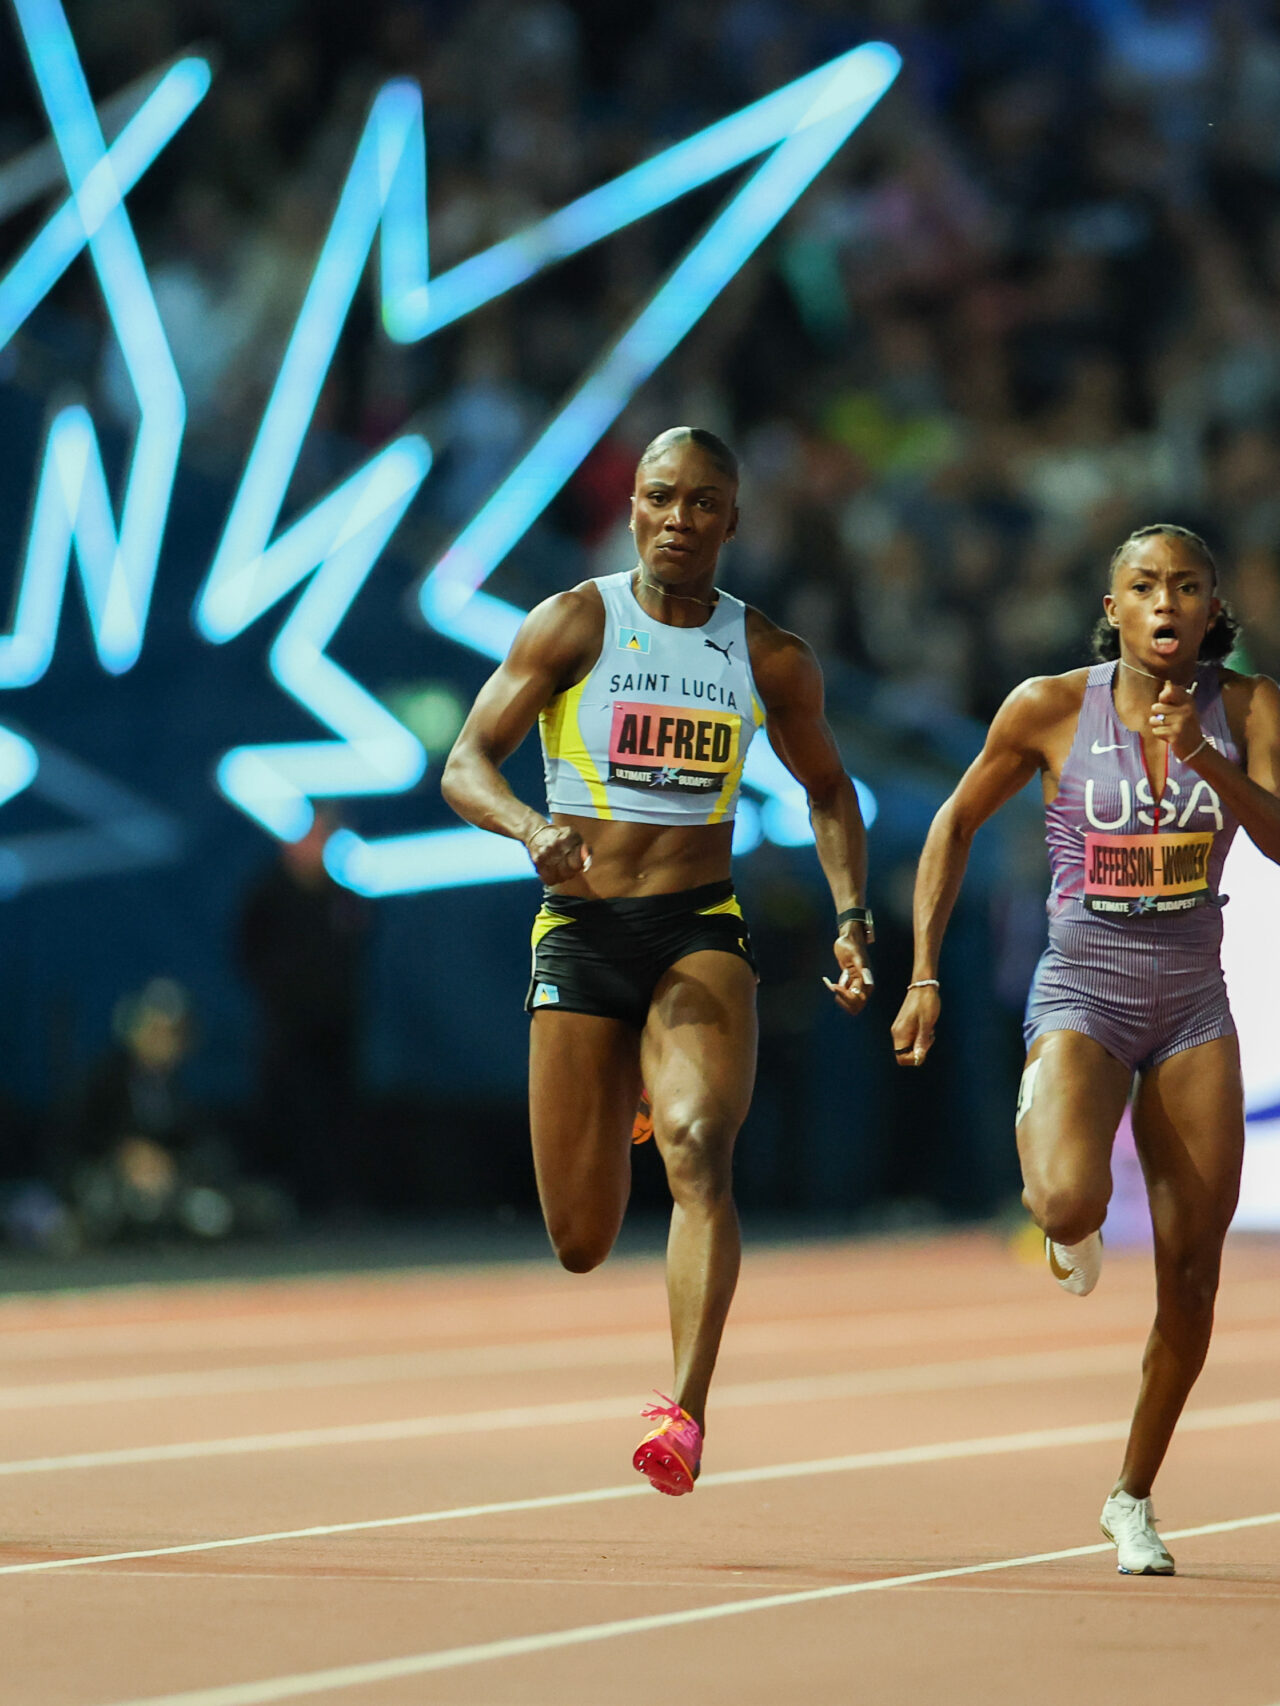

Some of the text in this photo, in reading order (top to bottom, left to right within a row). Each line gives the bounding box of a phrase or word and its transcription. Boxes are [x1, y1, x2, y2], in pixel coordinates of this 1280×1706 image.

[610, 673, 737, 709] SAINT LUCIA
[617, 714, 732, 763] ALFRED
[615, 768, 652, 782] ULTIMATE
[1085, 777, 1223, 830] USA
[1092, 898, 1196, 912] ULTIMATE BUDAPEST
